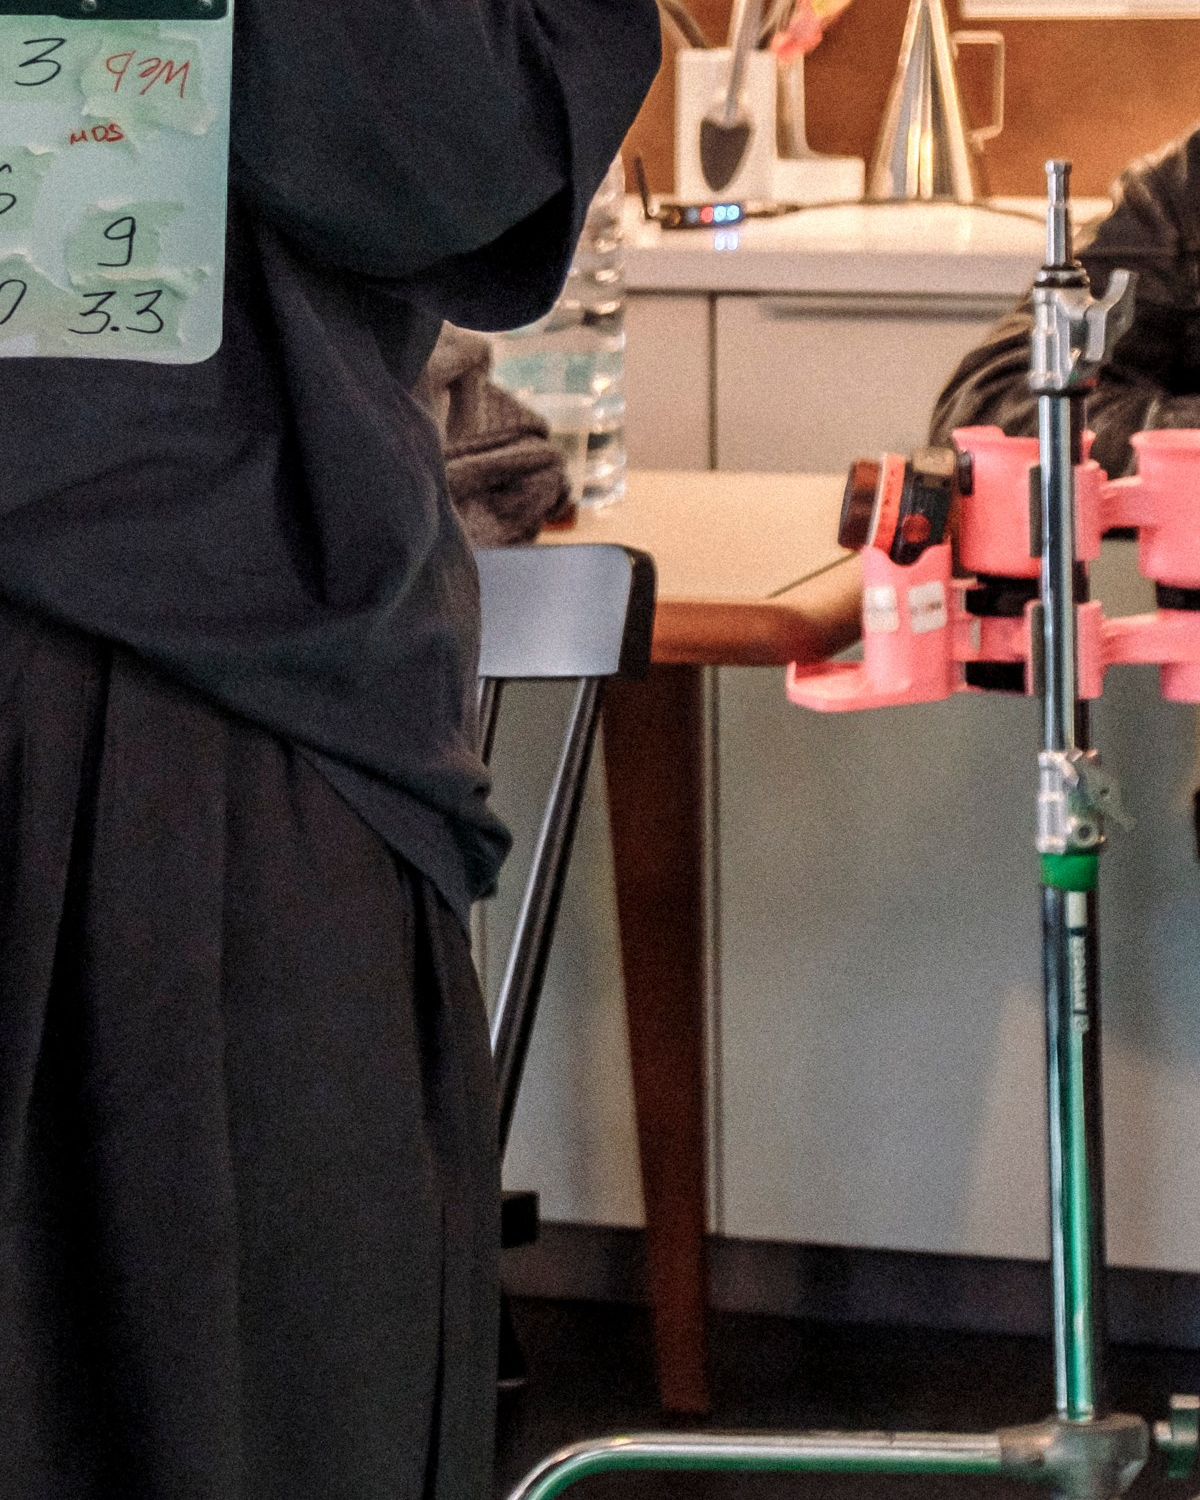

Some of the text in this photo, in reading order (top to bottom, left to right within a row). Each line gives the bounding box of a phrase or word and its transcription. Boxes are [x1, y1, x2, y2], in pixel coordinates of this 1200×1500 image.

[15, 37, 68, 87] 3
[97, 215, 137, 267] 9
[66, 289, 165, 335] 3.3
